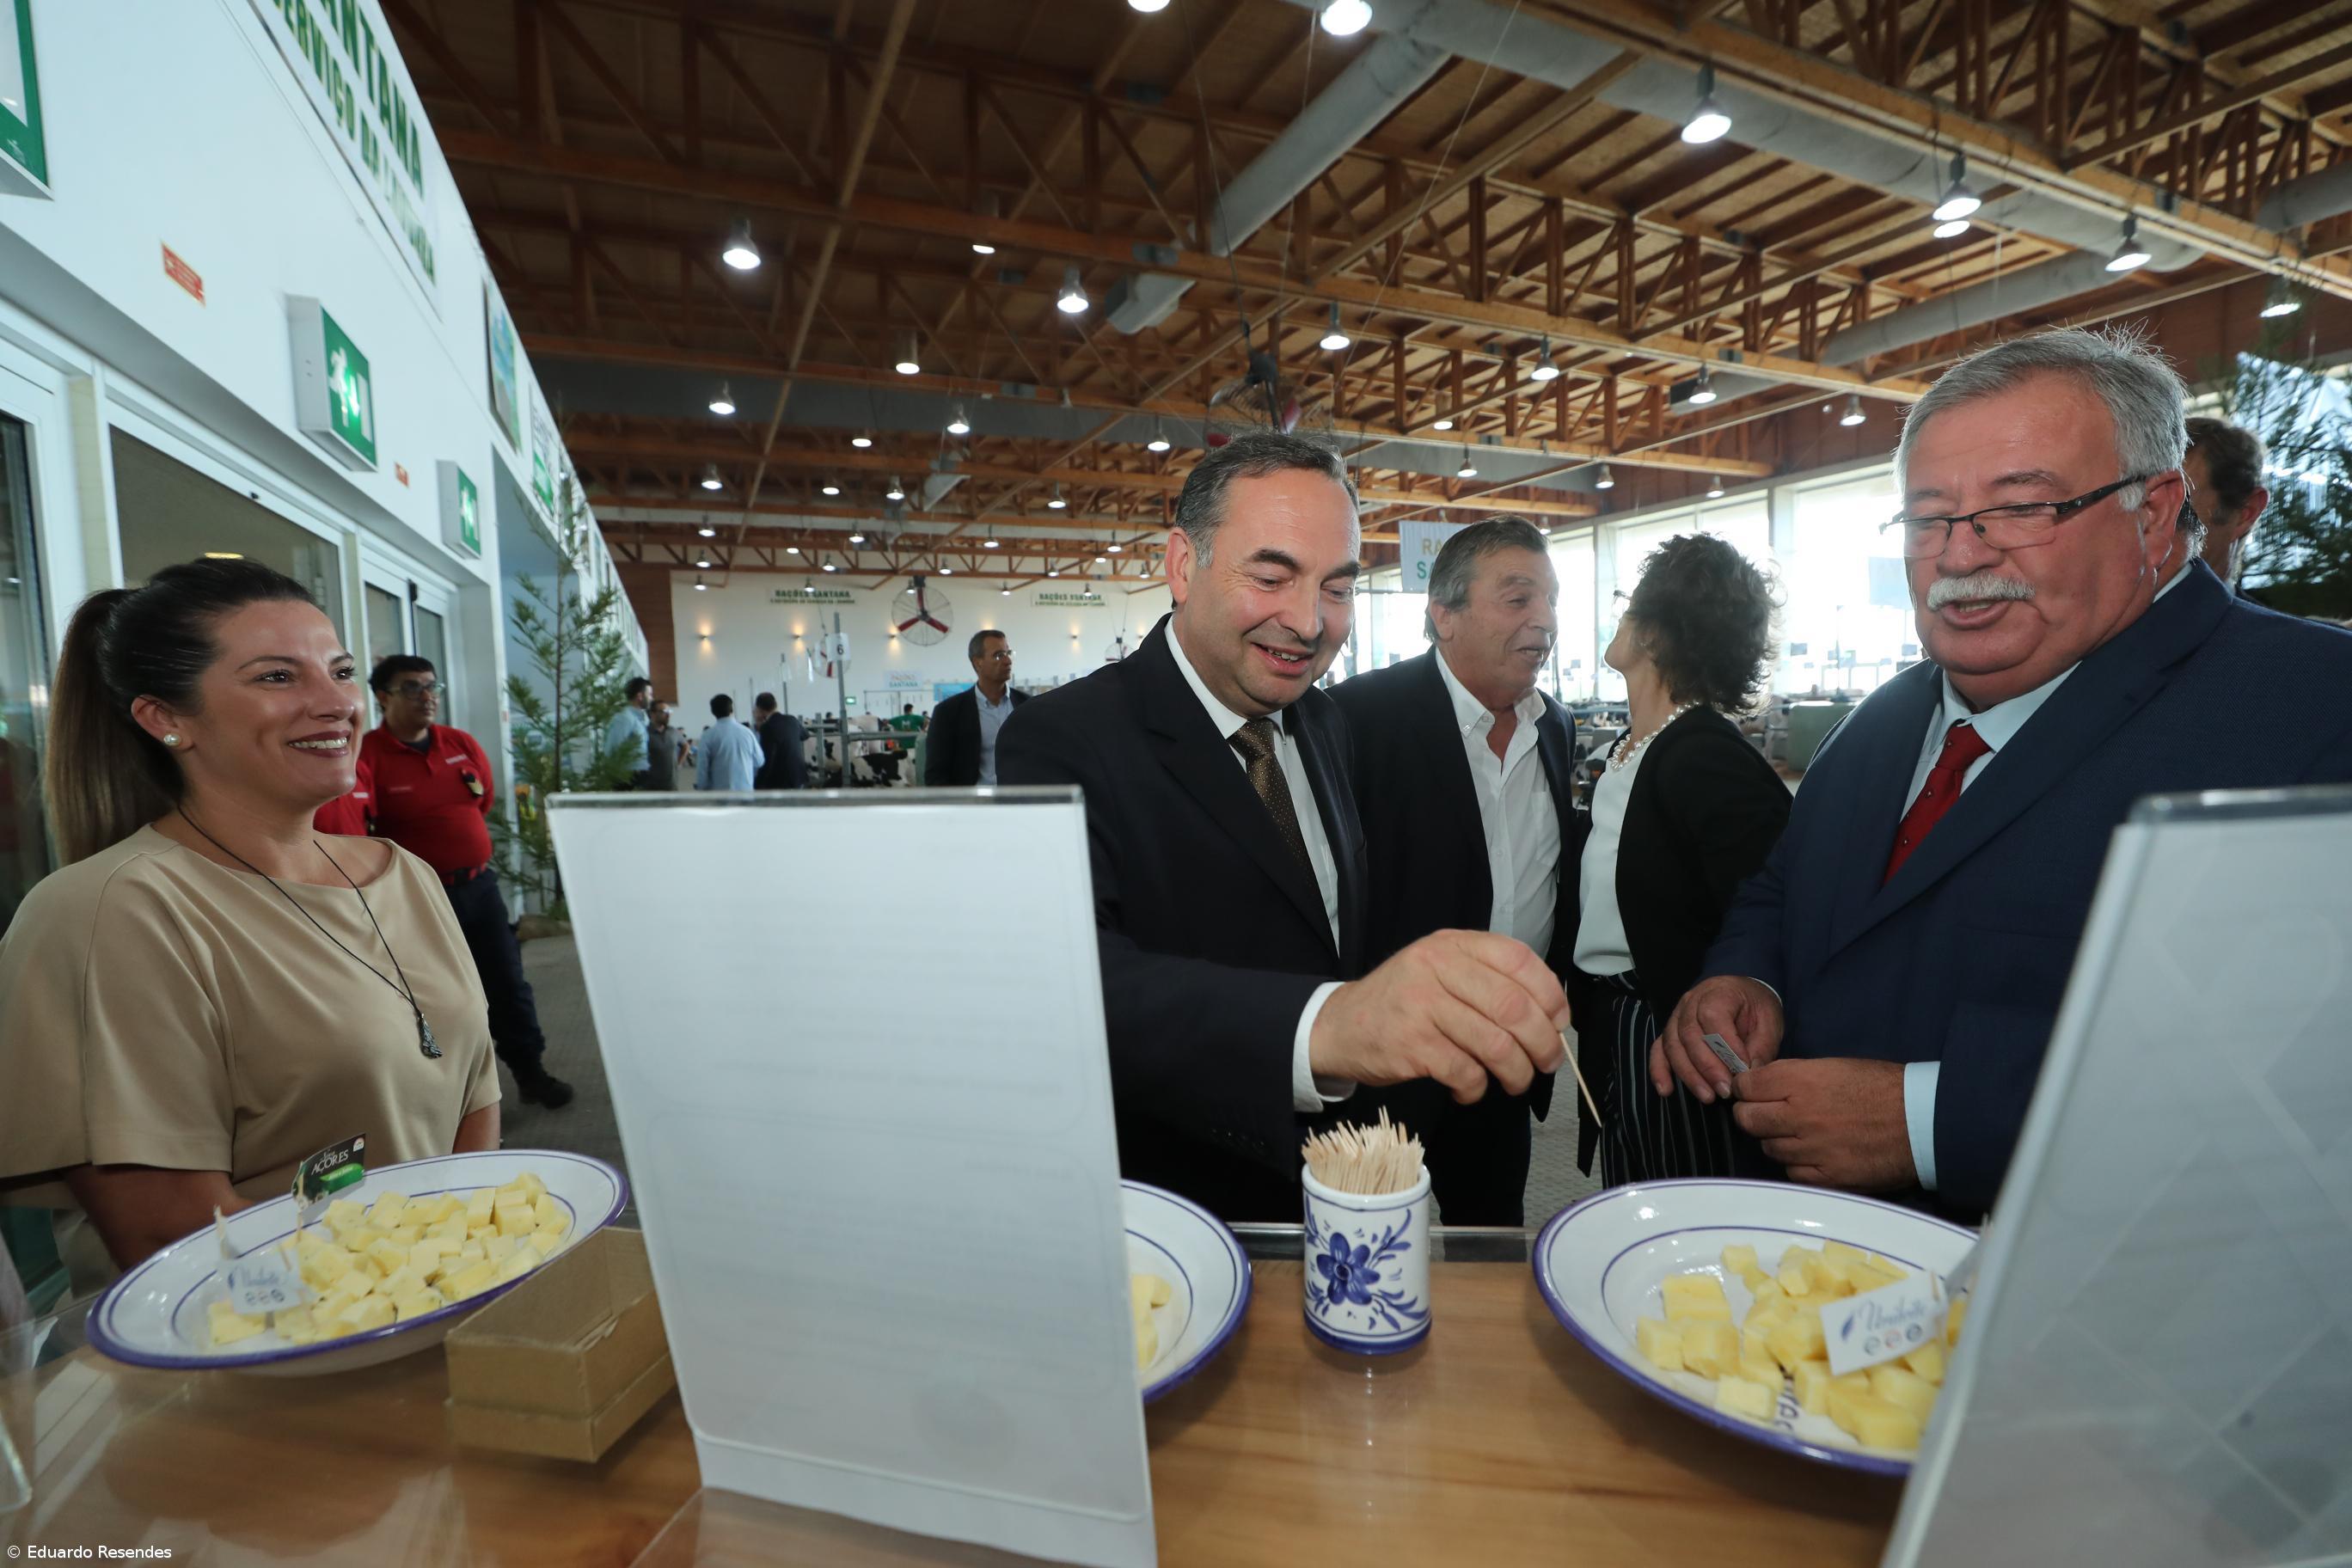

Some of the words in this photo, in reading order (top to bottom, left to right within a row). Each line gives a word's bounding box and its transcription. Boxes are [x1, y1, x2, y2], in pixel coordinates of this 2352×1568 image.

[273, 0, 355, 141] ERVIÇO
[836, 644, 844, 655] 6
[311, 1148, 349, 1176] AÇORES
